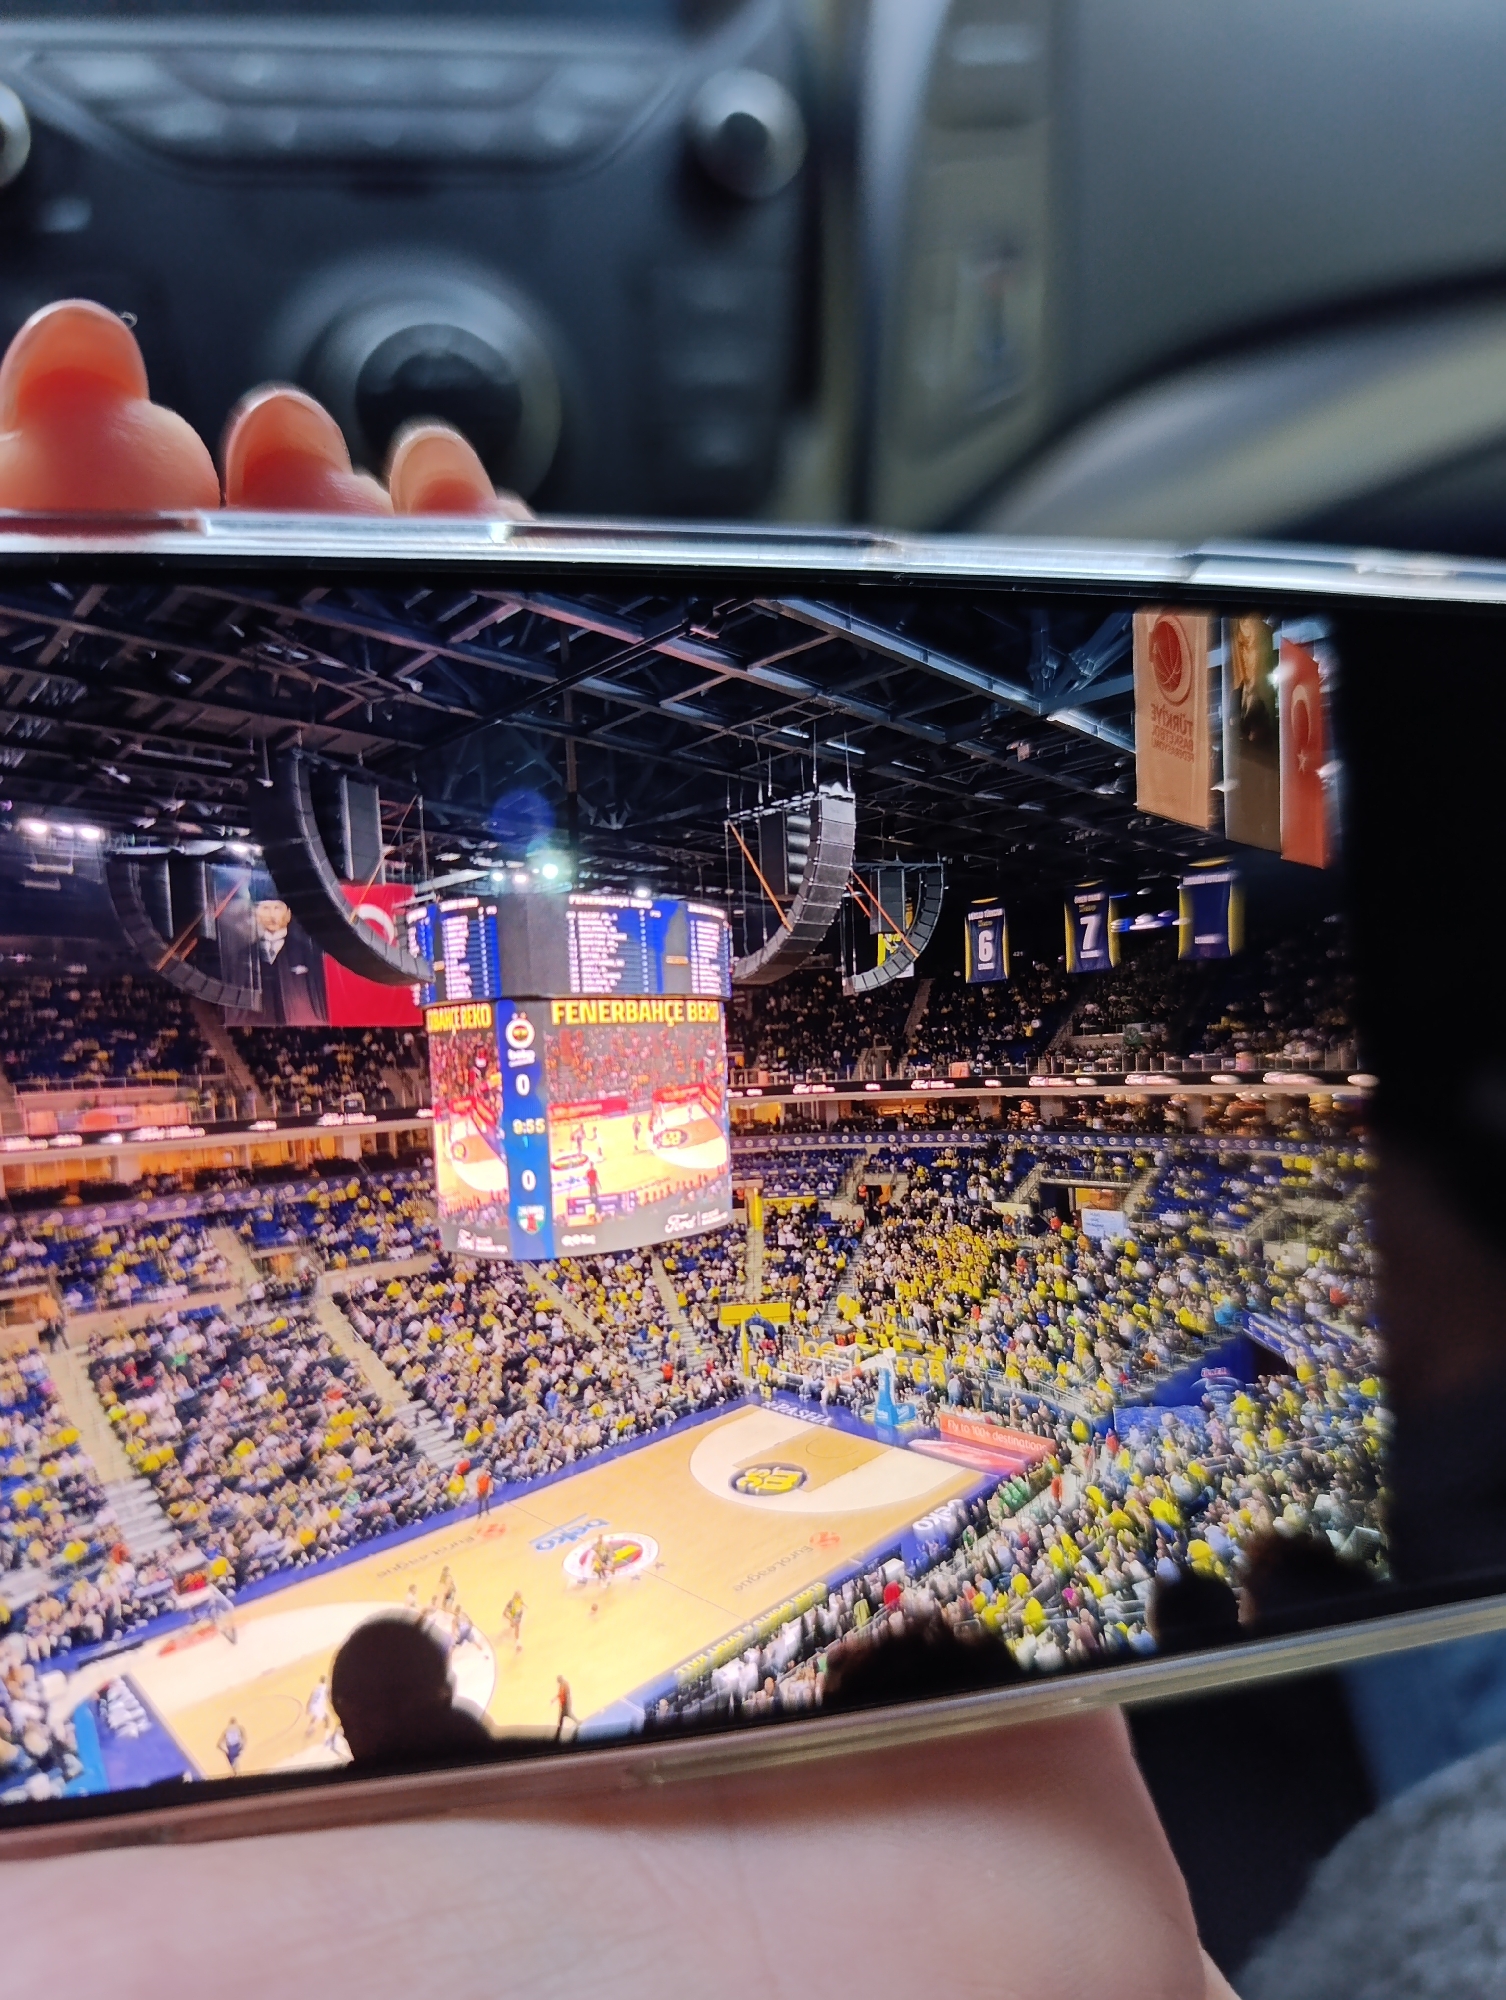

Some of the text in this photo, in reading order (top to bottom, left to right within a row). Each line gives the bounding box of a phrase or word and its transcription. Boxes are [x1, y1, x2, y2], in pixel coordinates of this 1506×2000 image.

[1080, 914, 1101, 950] 7
[979, 930, 993, 962] 6
[460, 1003, 492, 1030] BEKO
[551, 1000, 719, 1027] FENERBAHÇE BEKO
[515, 1074, 530, 1096] 0
[521, 1169, 536, 1192] 0
[665, 1212, 697, 1234] Ford
[947, 1419, 960, 1432] Fly
[961, 1424, 970, 1432] to
[971, 1425, 991, 1438] 100+
[733, 1545, 813, 1592] EuroLeague
